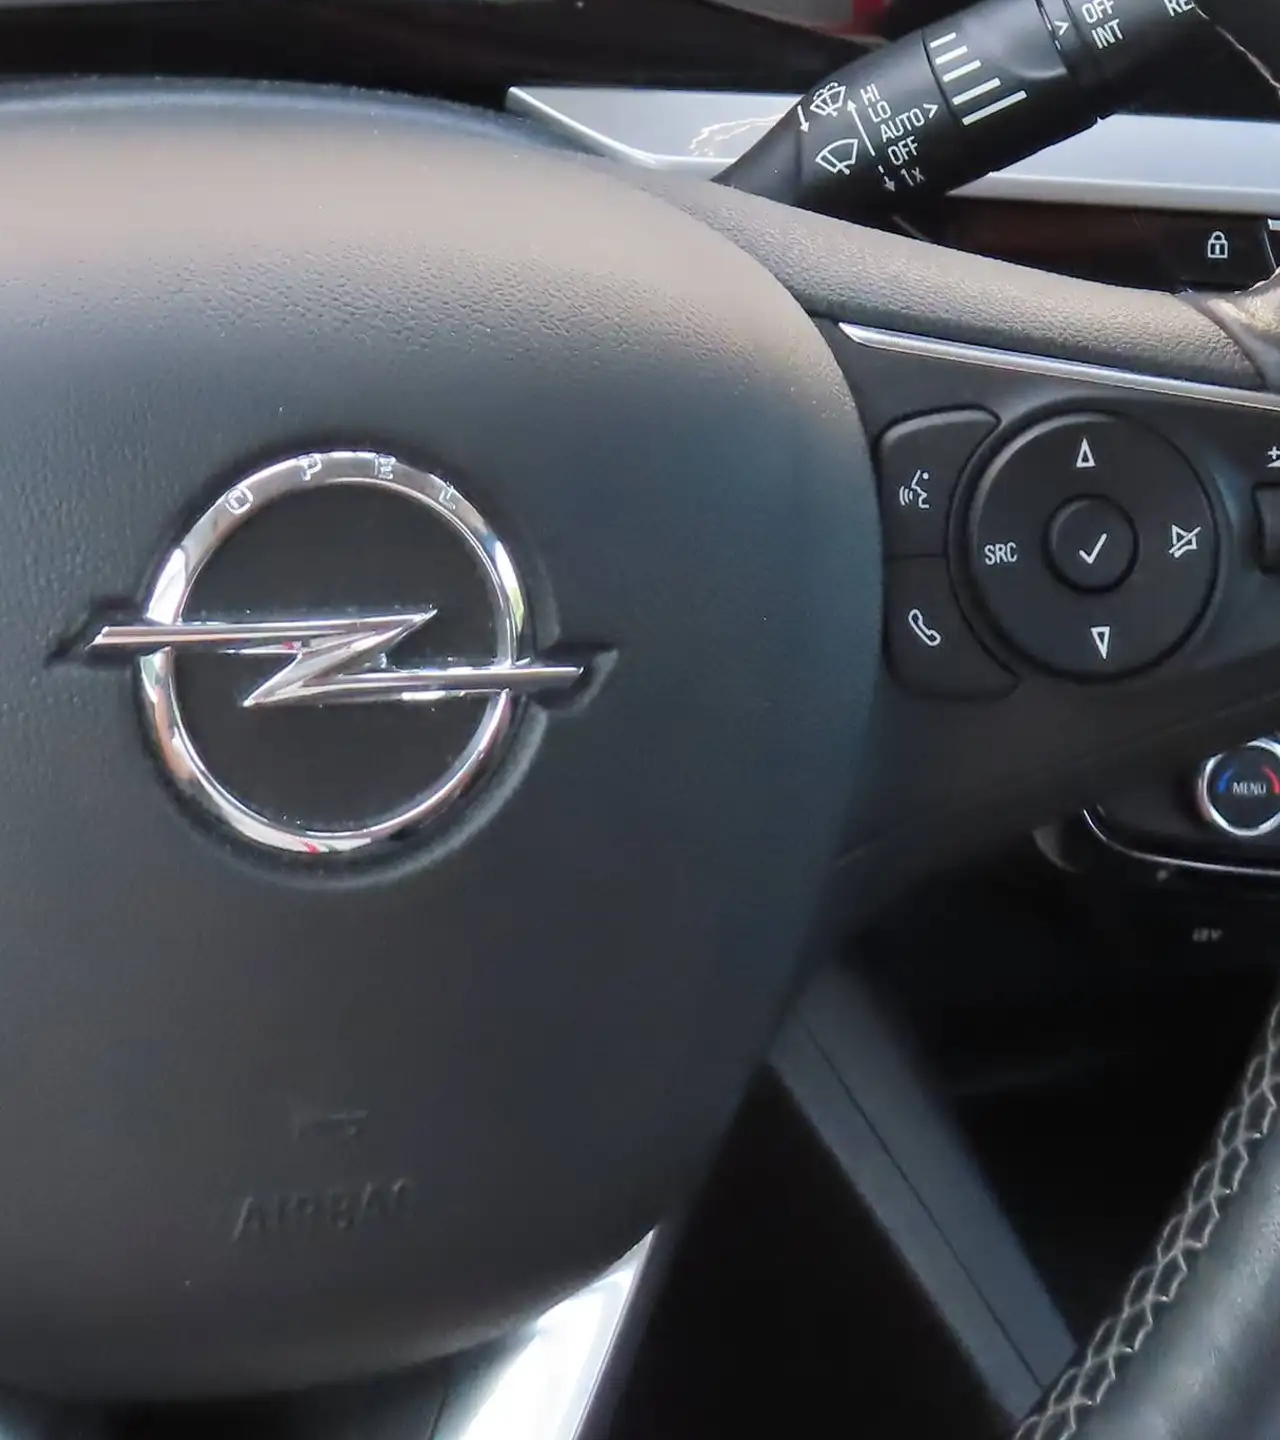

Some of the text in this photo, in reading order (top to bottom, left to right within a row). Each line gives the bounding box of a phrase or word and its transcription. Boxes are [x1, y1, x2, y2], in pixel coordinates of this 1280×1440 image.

[1091, 18, 1123, 49] INT
[860, 83, 880, 106] HI
[867, 101, 891, 123] LO
[880, 108, 925, 143] AUTO
[887, 135, 918, 166] OFF
[984, 543, 1018, 566] SRC
[1232, 781, 1267, 796] MENU
